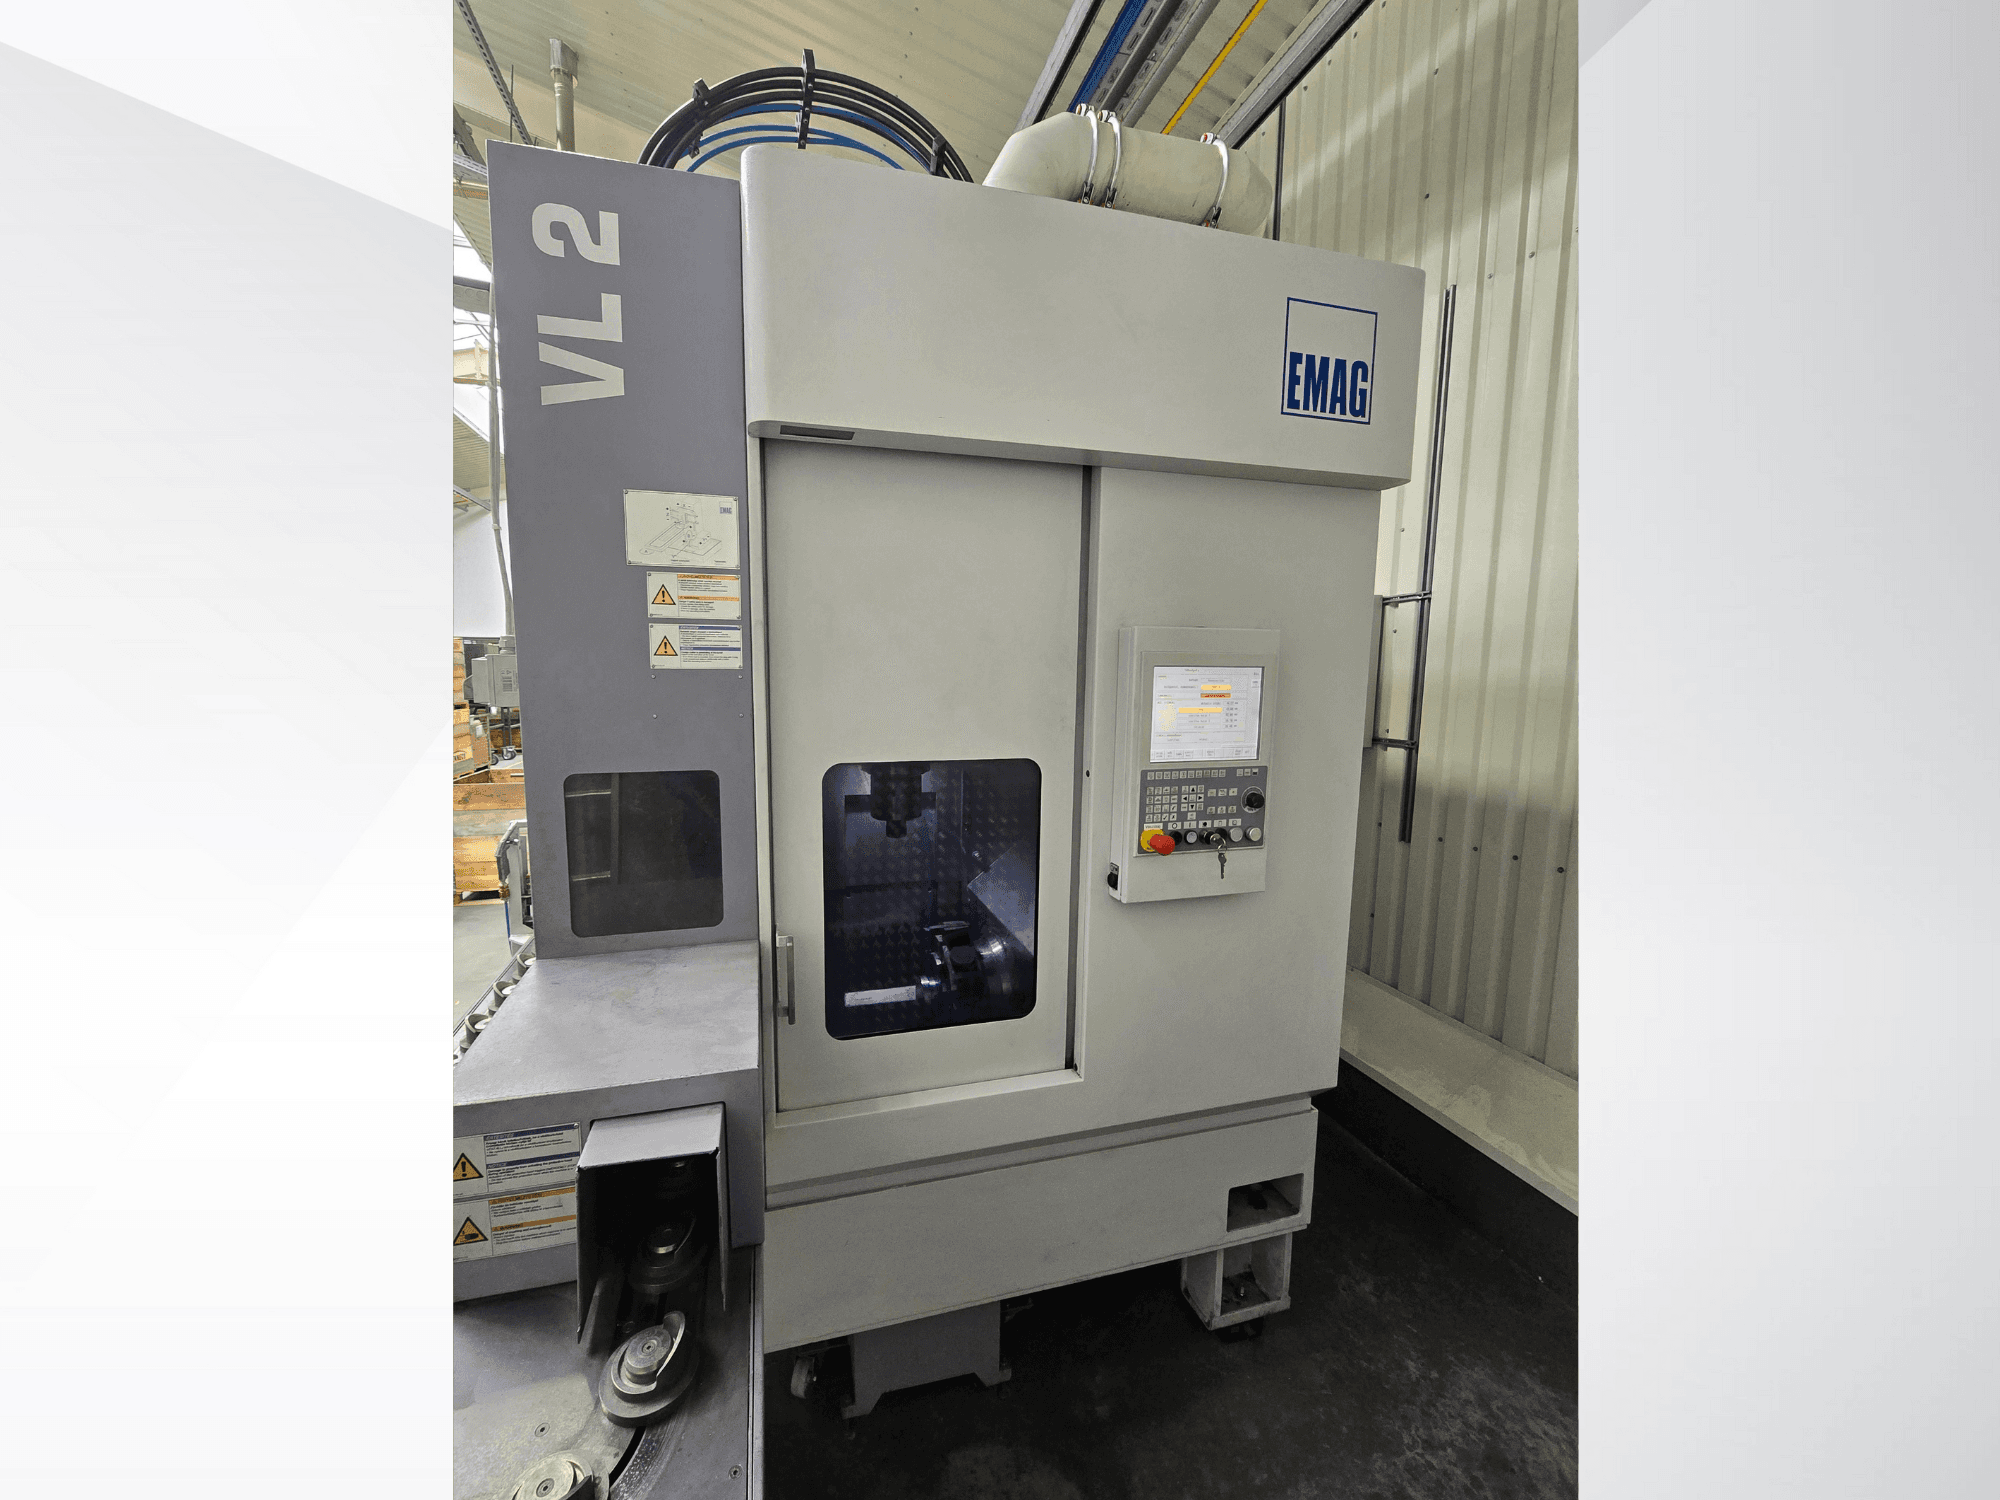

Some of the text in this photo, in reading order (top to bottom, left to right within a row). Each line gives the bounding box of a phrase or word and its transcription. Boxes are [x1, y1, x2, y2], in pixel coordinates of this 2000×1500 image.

[531, 202, 625, 406] VL 2
[1286, 351, 1369, 419] EMAG
[719, 506, 732, 514] EMAG
